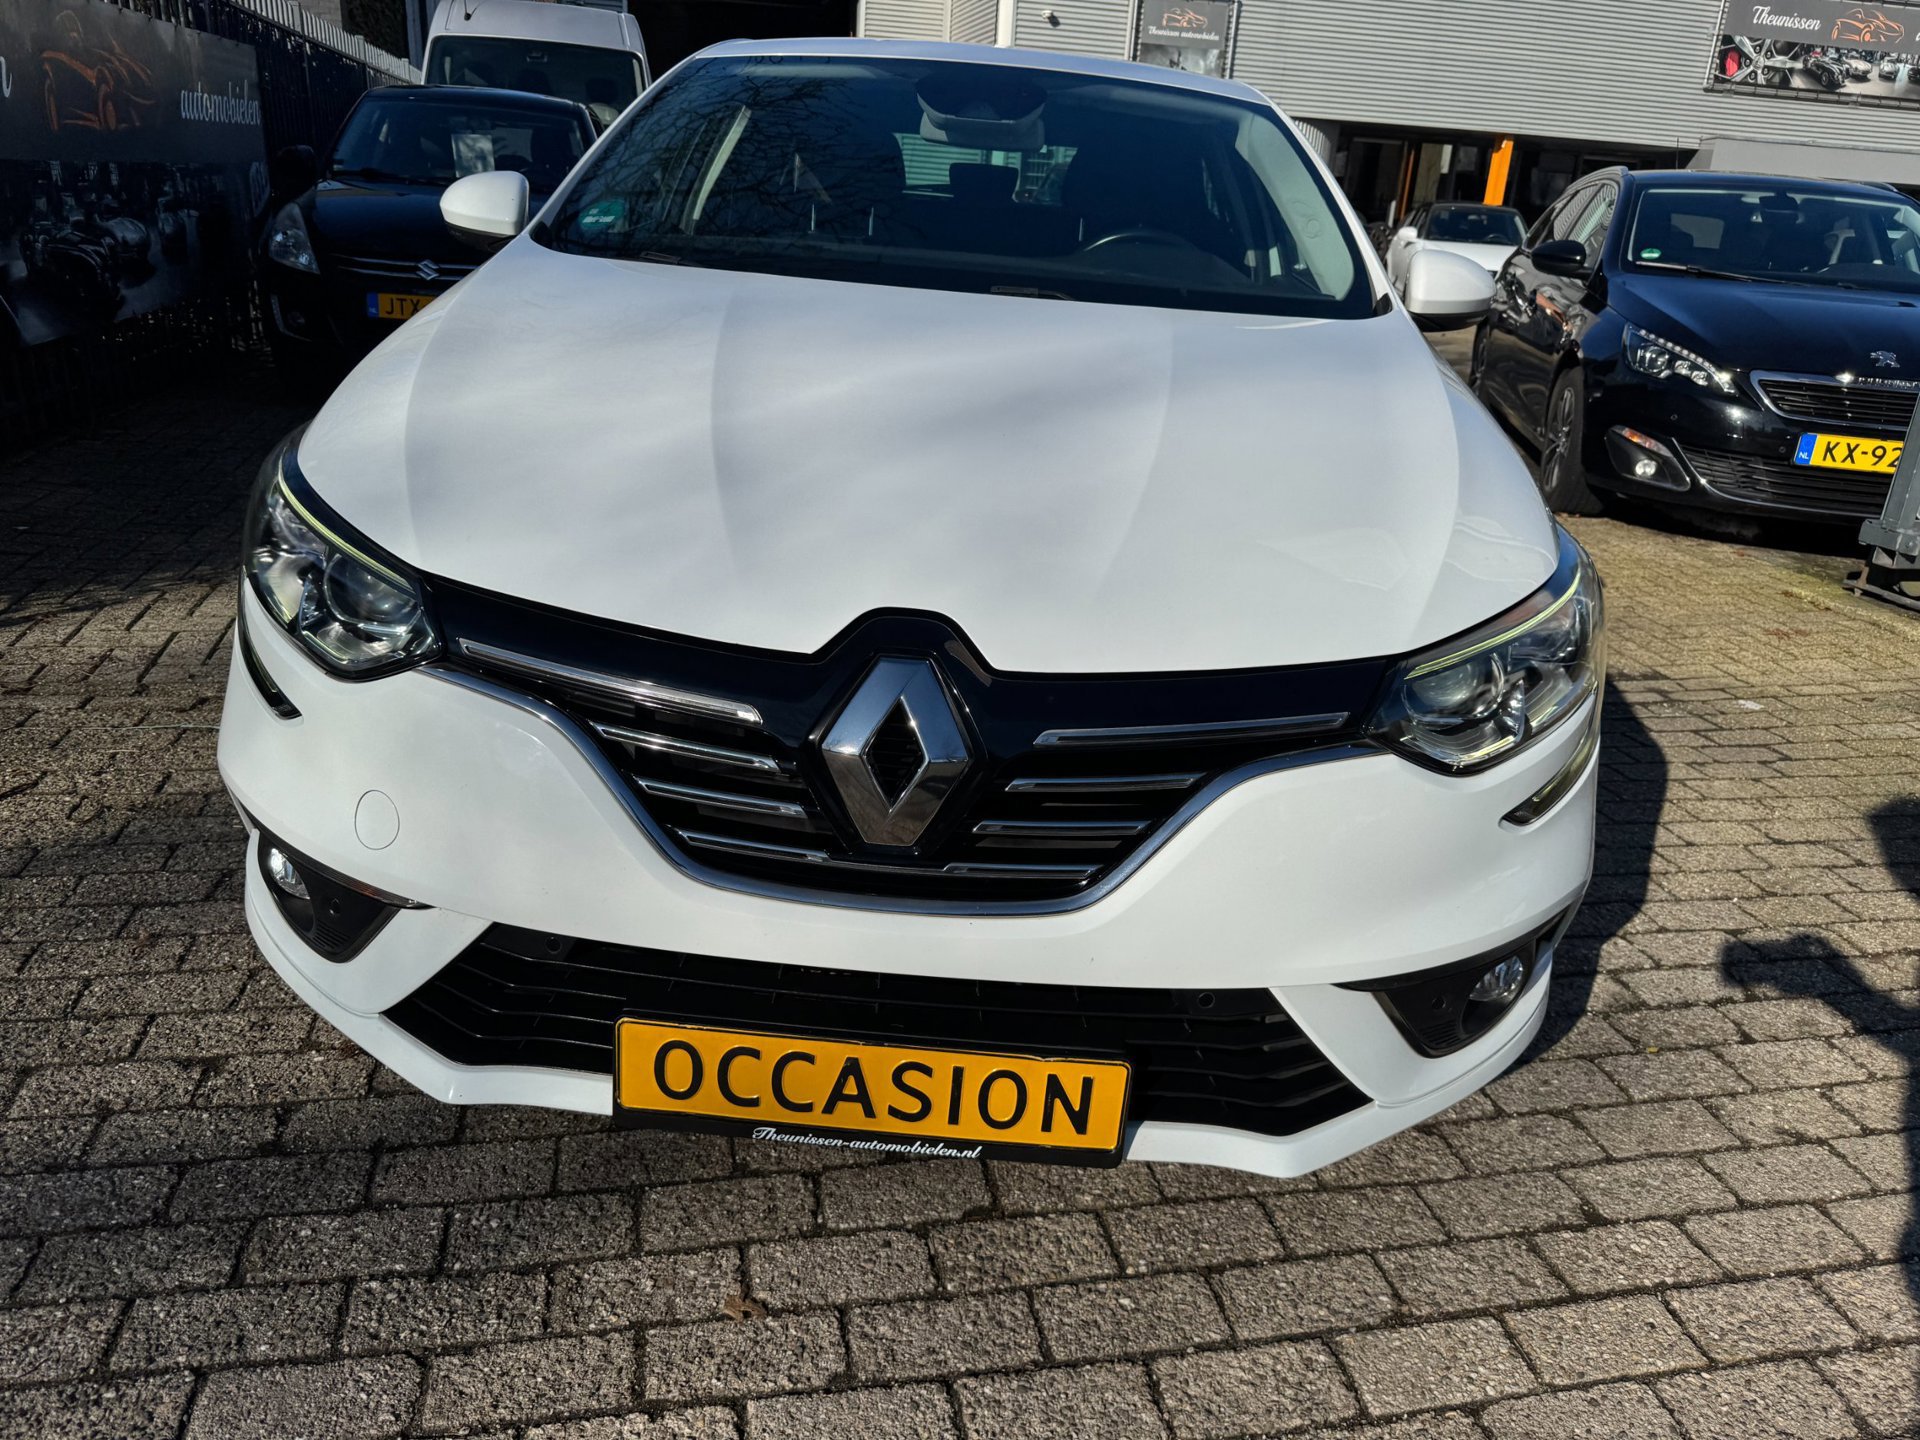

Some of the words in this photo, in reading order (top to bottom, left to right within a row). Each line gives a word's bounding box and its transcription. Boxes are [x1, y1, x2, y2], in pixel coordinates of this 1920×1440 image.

[1752, 5, 1821, 31] Theunissen
[180, 79, 262, 126] automobielen
[1799, 451, 1809, 460] NL
[653, 1039, 1094, 1136] OCCASION
[752, 1126, 982, 1159] Theunissen-automobielen.nl
